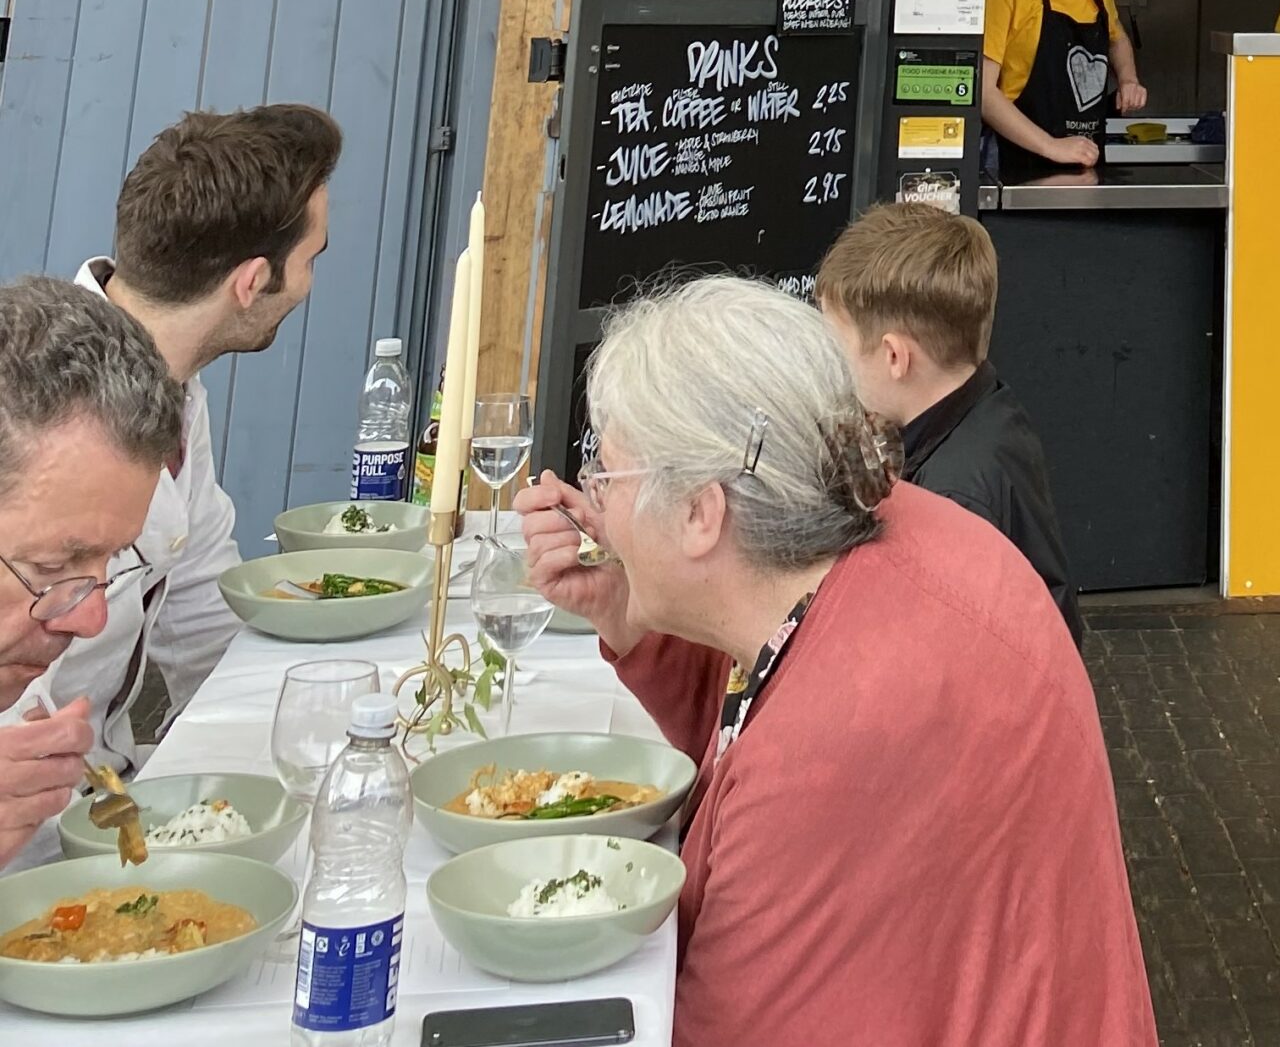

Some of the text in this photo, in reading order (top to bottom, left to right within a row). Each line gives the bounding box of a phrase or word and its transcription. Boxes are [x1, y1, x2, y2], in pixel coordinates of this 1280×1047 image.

[687, 35, 779, 91] DRINKS
[766, 81, 789, 92] STILL
[663, 96, 728, 129] COFFEE
[731, 98, 742, 113] OR
[748, 88, 800, 123] WATER
[917, 181, 940, 193] GIFT
[904, 192, 952, 203] VOUCHER
[361, 452, 404, 466] PURPOSE
